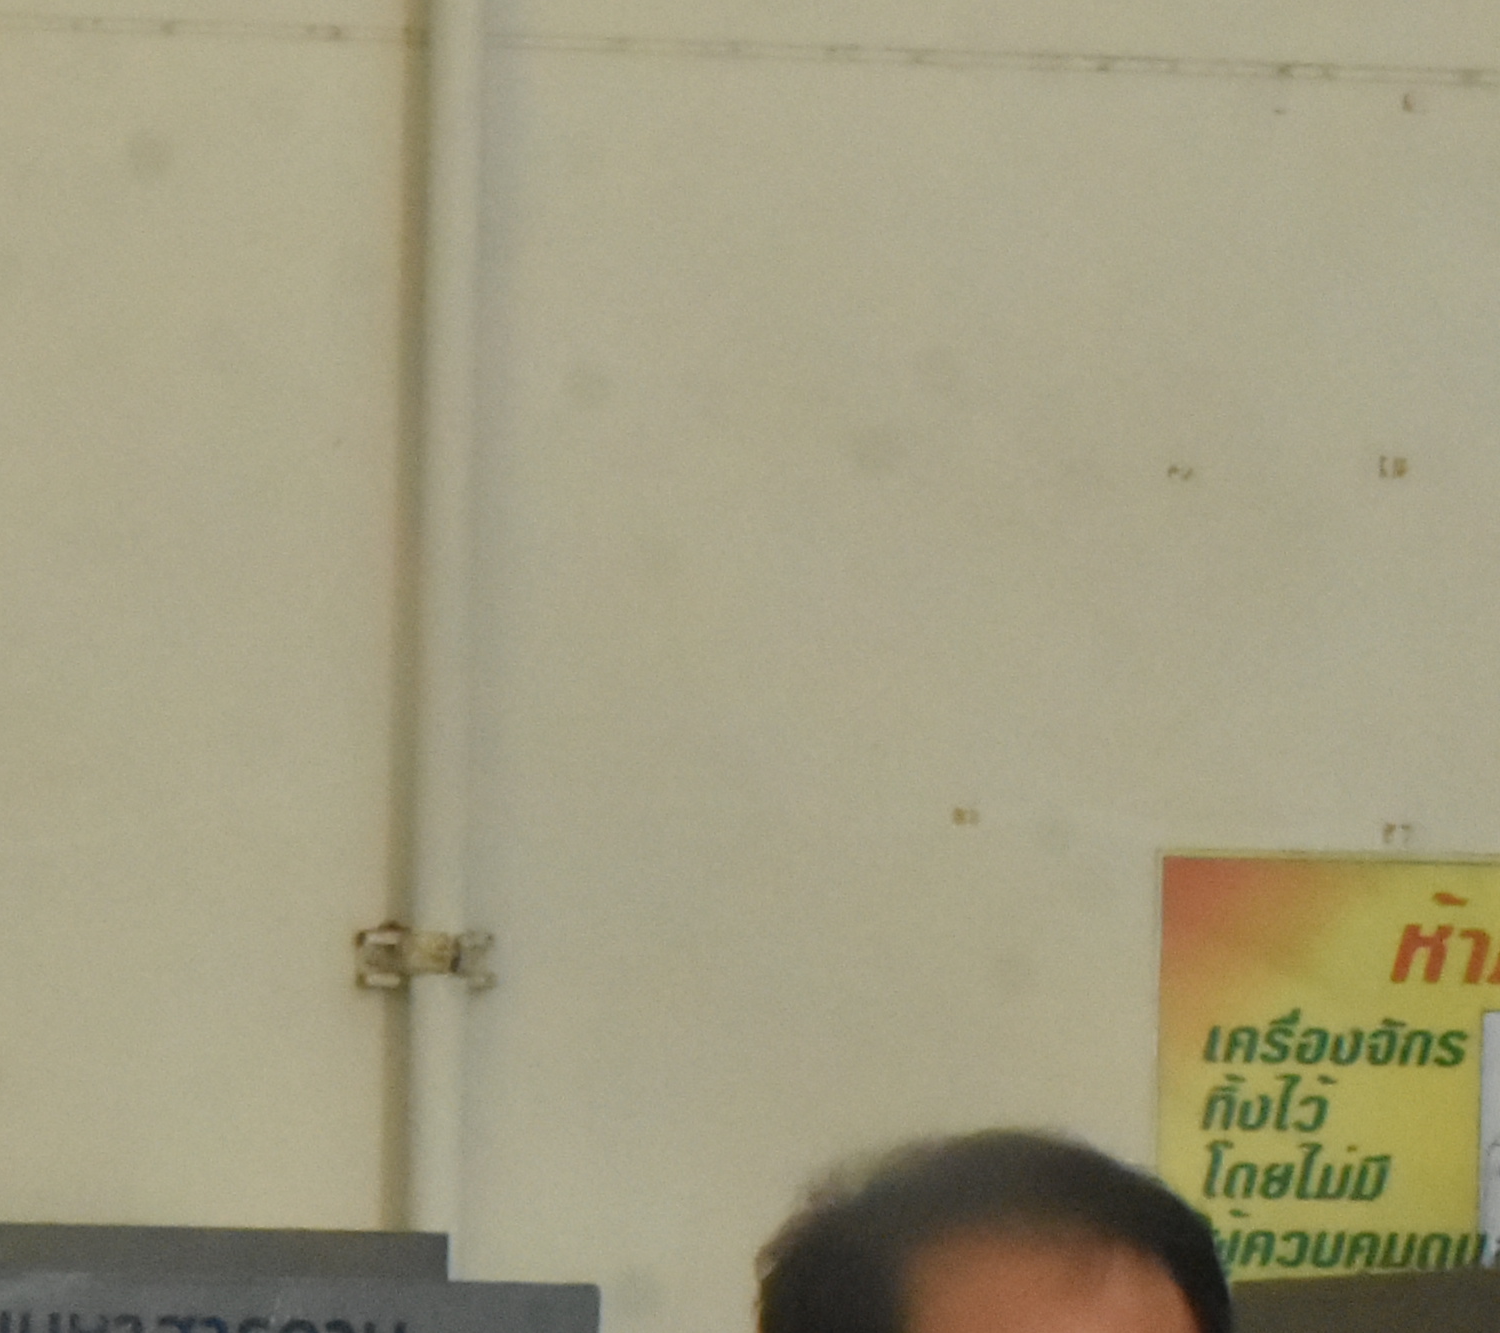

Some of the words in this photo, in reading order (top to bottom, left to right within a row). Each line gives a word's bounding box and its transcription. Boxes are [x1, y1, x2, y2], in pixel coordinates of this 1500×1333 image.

[1202, 1008, 1469, 1068] เครื่องจักร
[1202, 1140, 1393, 1201] โดยไม่มี
